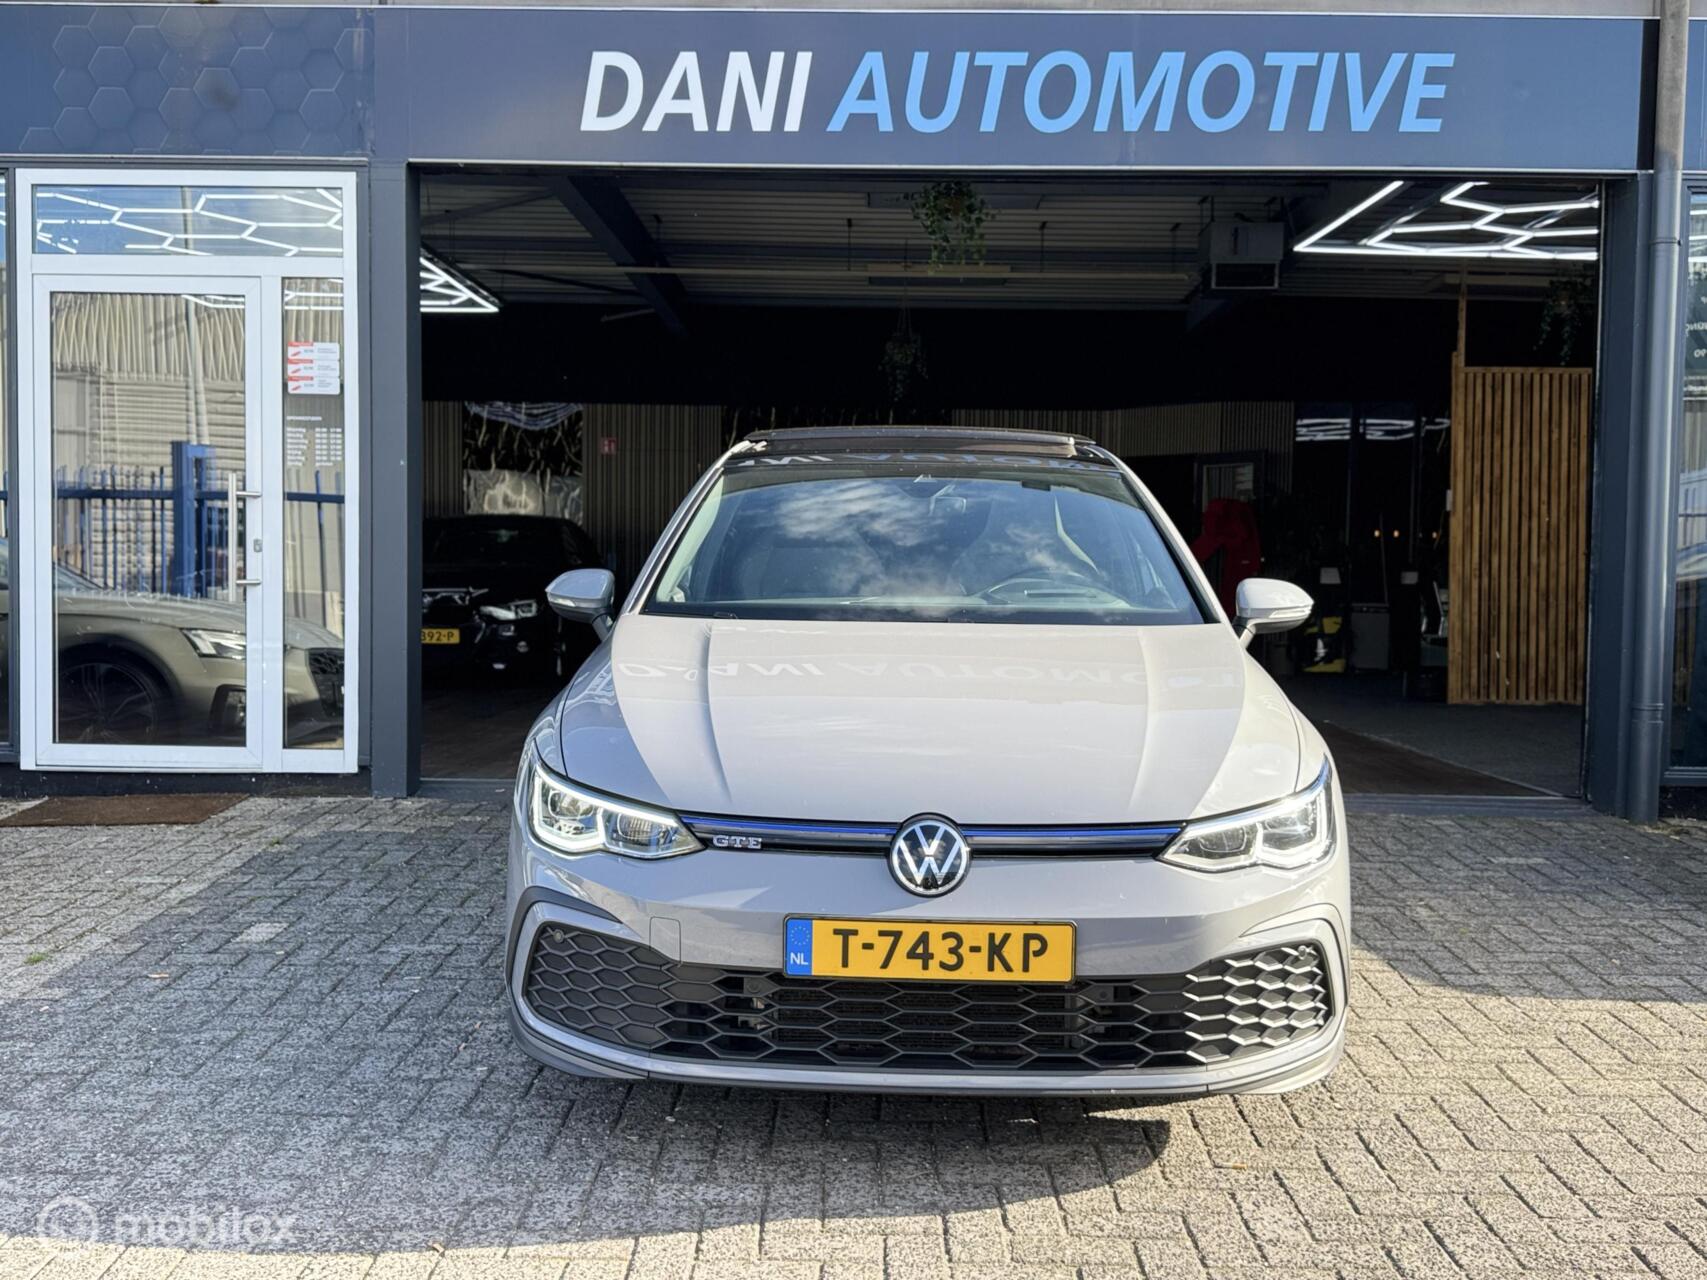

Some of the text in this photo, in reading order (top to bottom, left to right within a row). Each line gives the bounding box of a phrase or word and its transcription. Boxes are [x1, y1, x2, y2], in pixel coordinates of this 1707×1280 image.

[580, 50, 1456, 134] DANI AUTOMOTIVE
[712, 834, 763, 849] GTE
[790, 927, 1049, 973] NL T-743-KP
